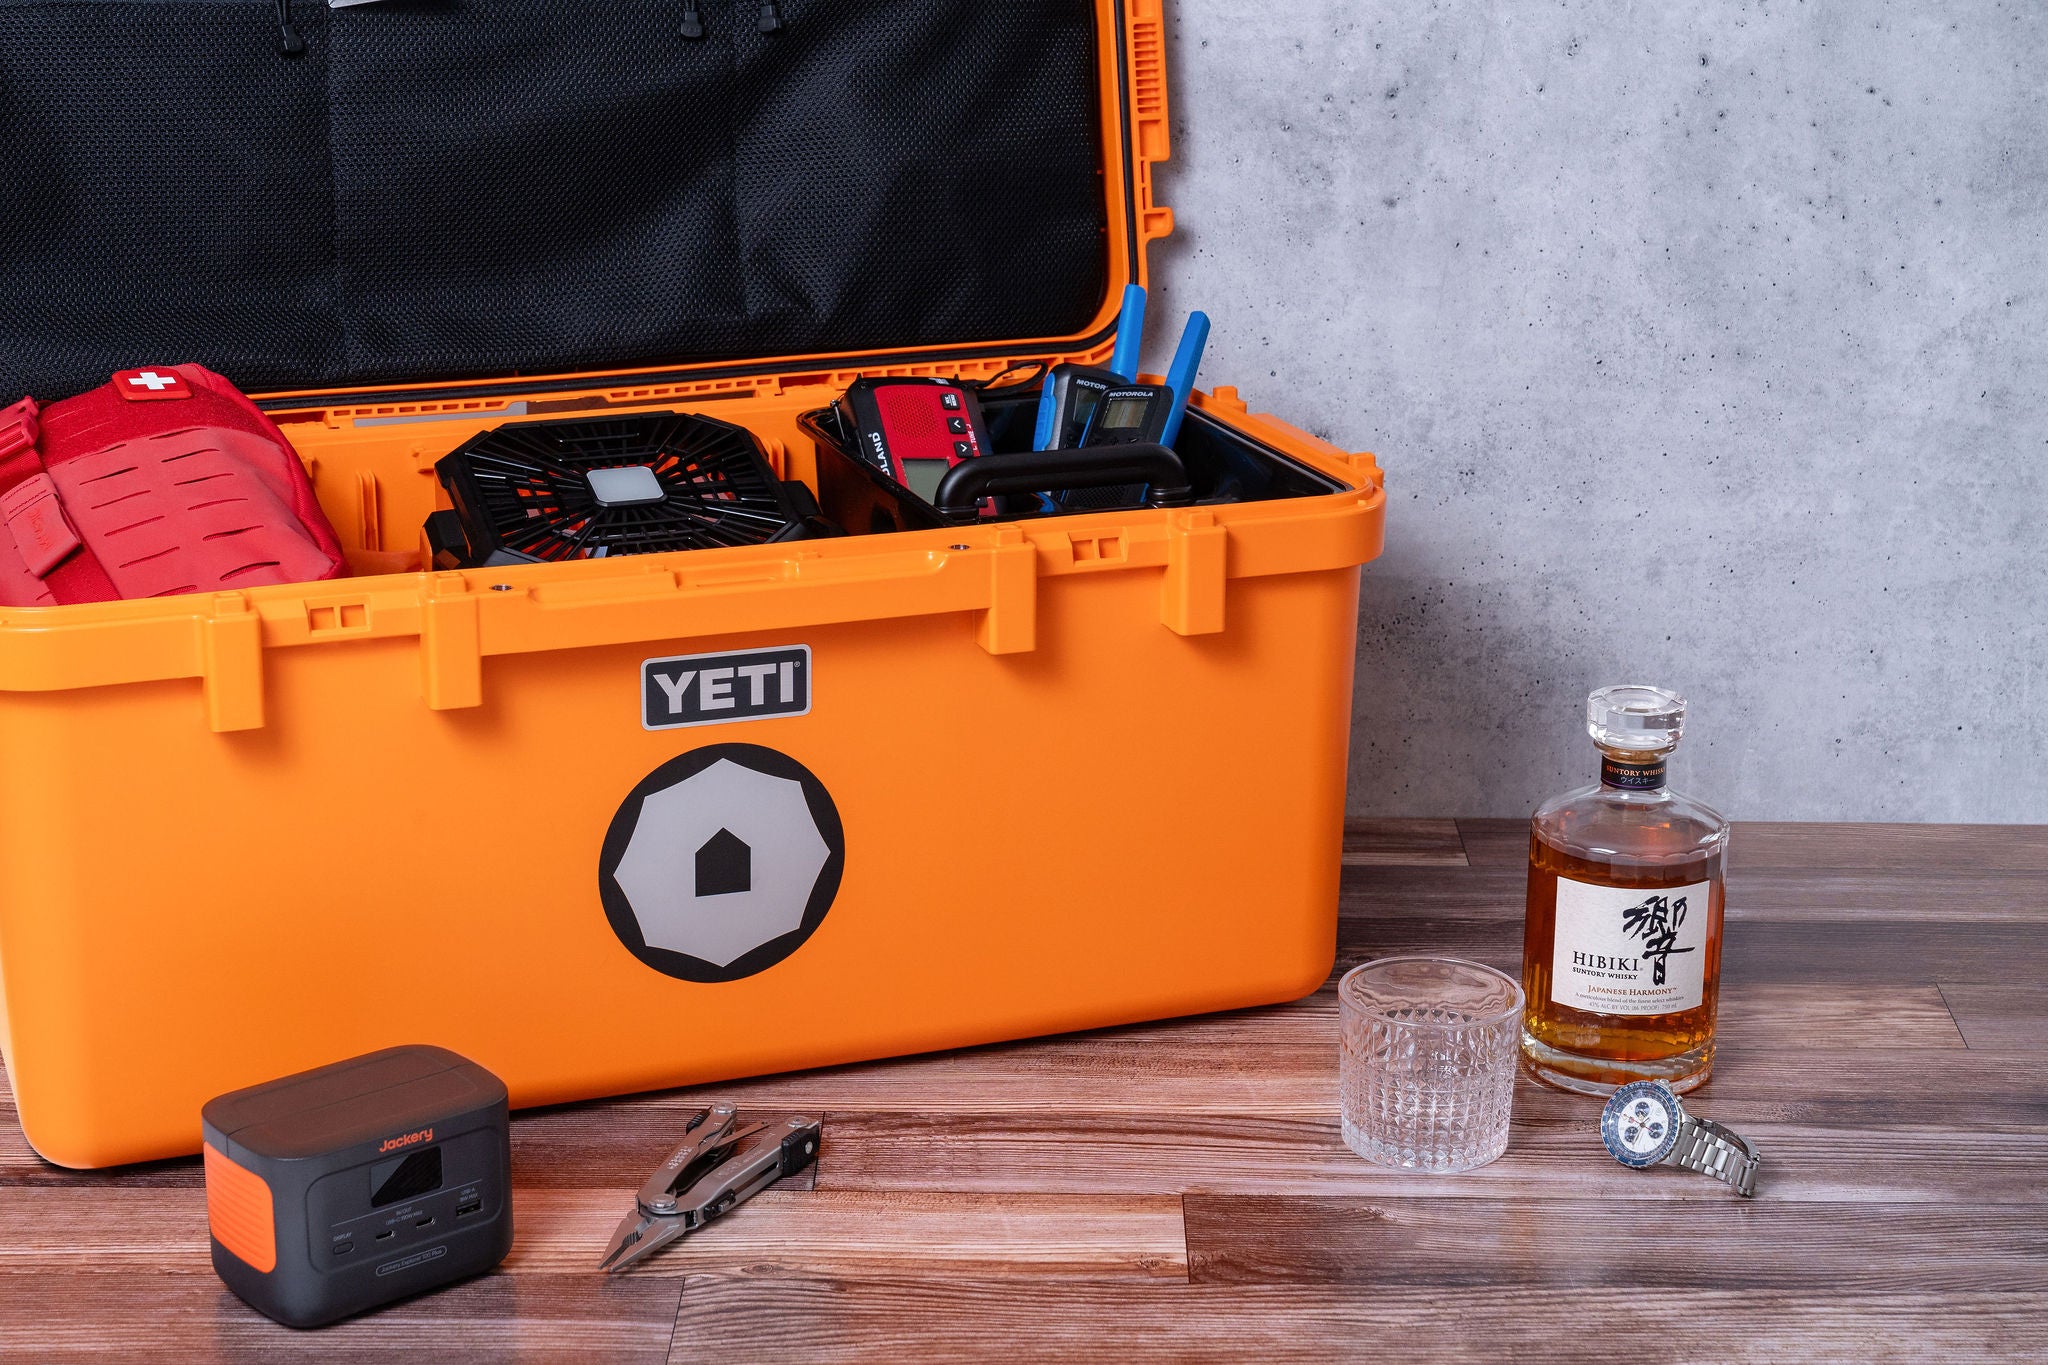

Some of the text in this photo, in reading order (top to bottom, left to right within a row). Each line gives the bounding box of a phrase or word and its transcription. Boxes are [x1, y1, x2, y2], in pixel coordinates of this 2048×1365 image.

[1076, 379, 1108, 390] MOTOR
[653, 661, 794, 714] YETI
[1606, 765, 1640, 777] SUNTORY
[1572, 950, 1639, 972] HIBIKI
[1572, 966, 1606, 978] SUNTORY
[379, 1128, 434, 1152] Jackery
